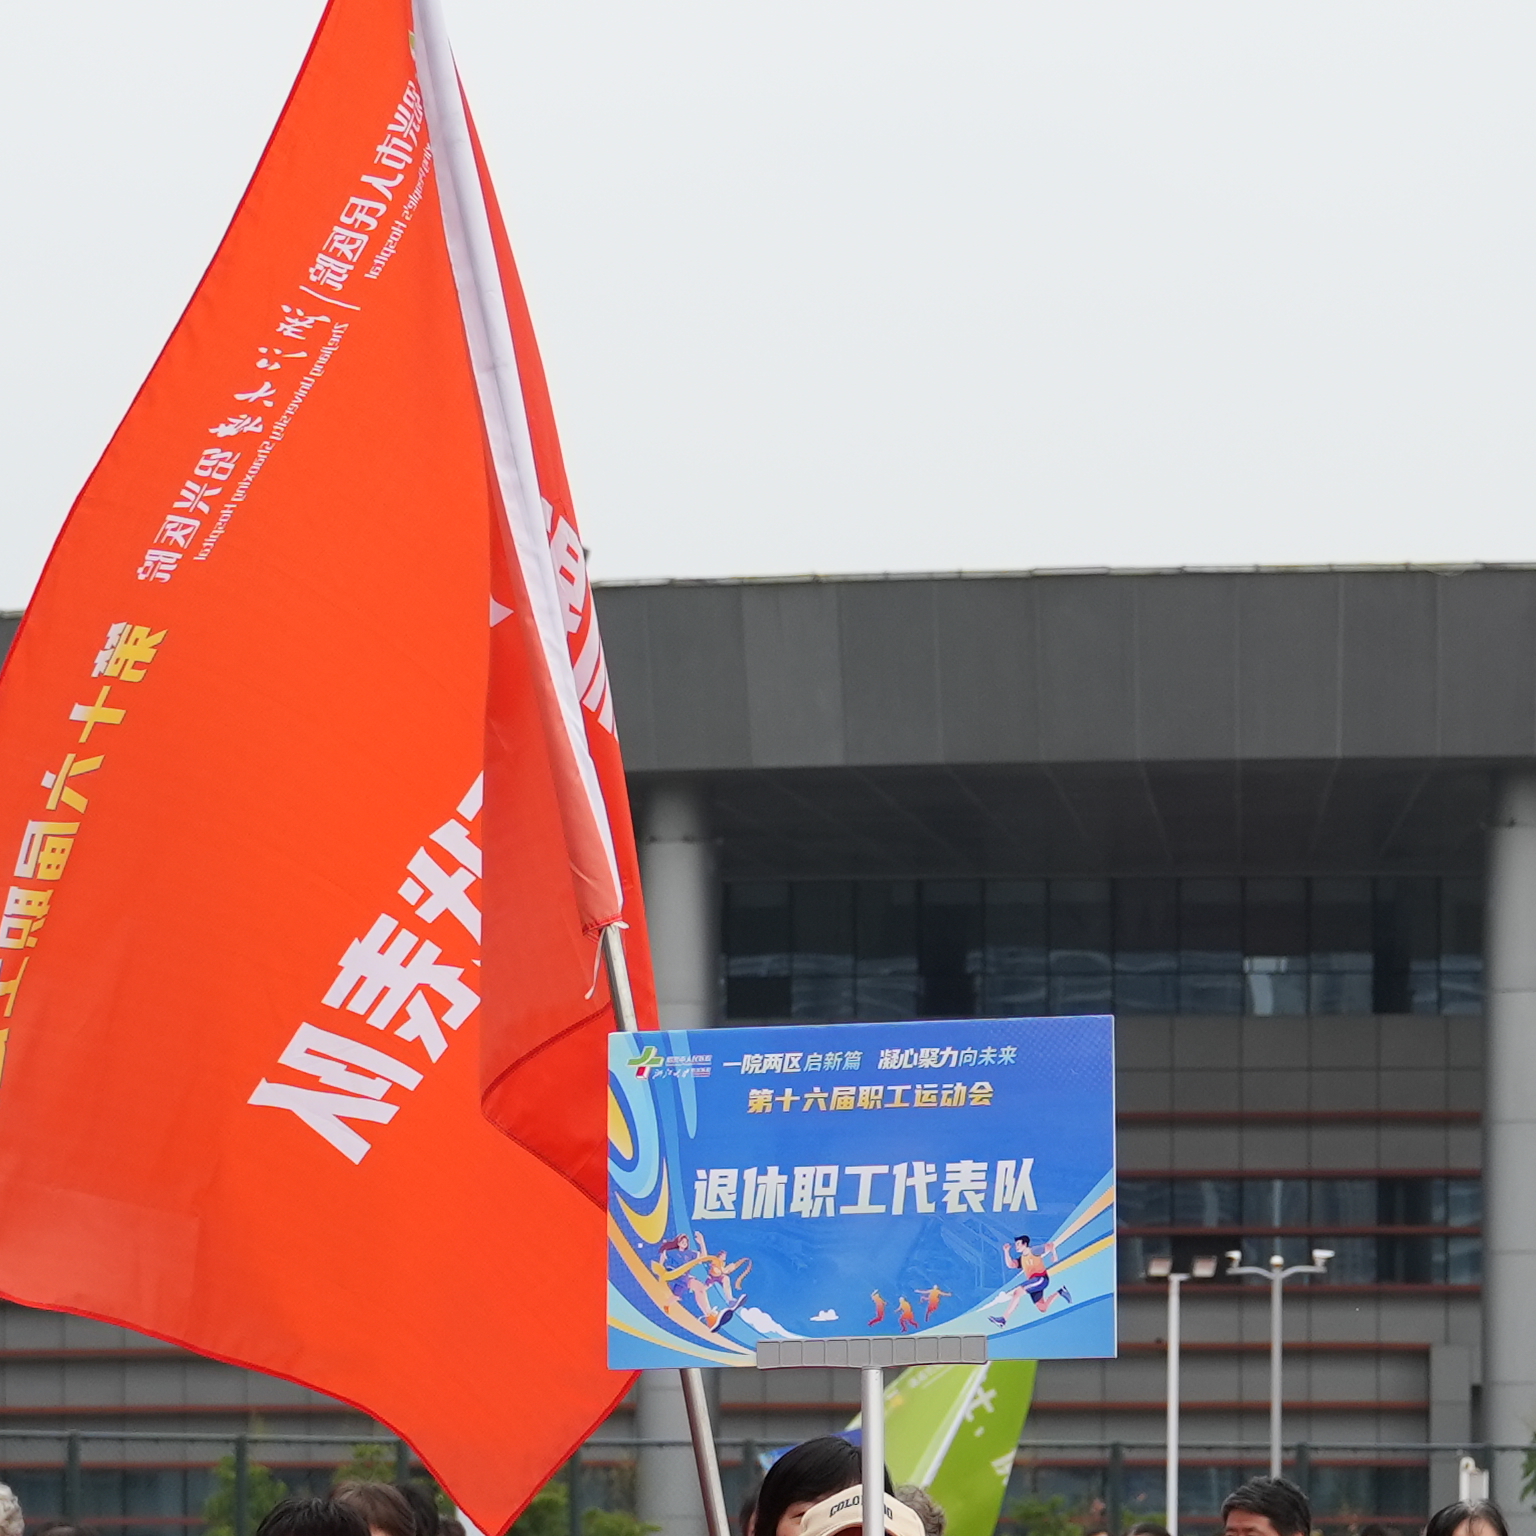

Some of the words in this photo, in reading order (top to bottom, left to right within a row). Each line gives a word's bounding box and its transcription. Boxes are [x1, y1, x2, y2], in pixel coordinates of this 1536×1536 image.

[722, 1050, 864, 1075] 一院两区启新篇
[877, 1045, 1018, 1070] 凝心聚力向未来
[747, 1081, 994, 1114] 第十六届职工运动会
[691, 1157, 1039, 1220] 退休职工代表队
